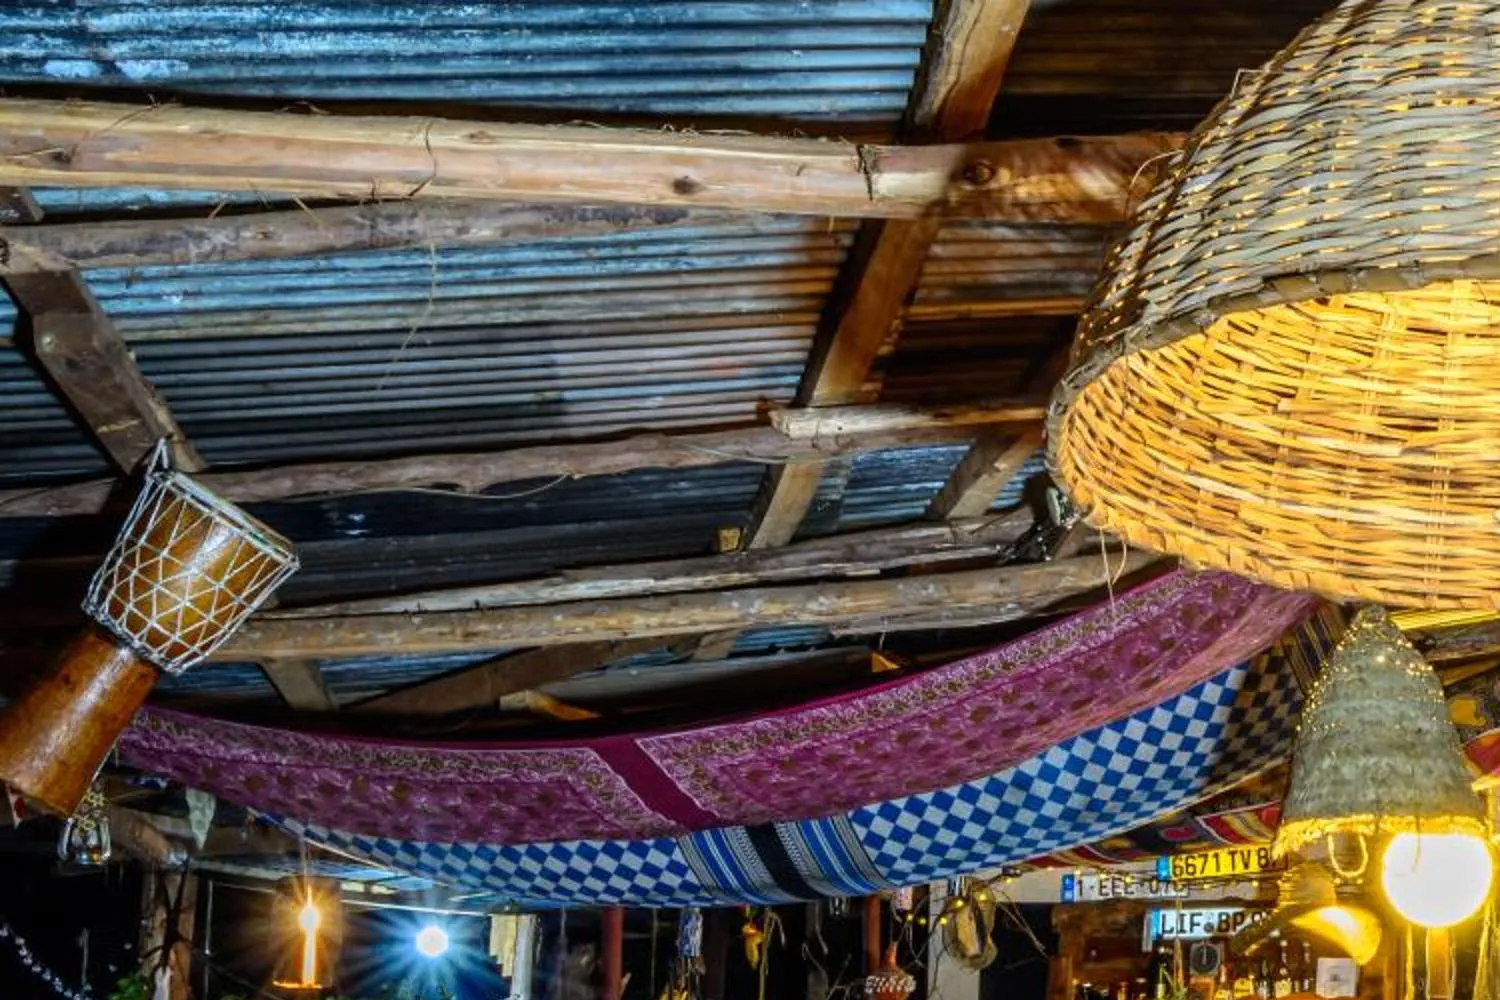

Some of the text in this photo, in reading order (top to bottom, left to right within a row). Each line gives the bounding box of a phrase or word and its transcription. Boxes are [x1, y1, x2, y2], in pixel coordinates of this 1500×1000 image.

[1172, 853, 1221, 877] 6671
[1229, 849, 1251, 871] TV
[1161, 911, 1203, 935] LIF
[1217, 911, 1244, 932] BP
